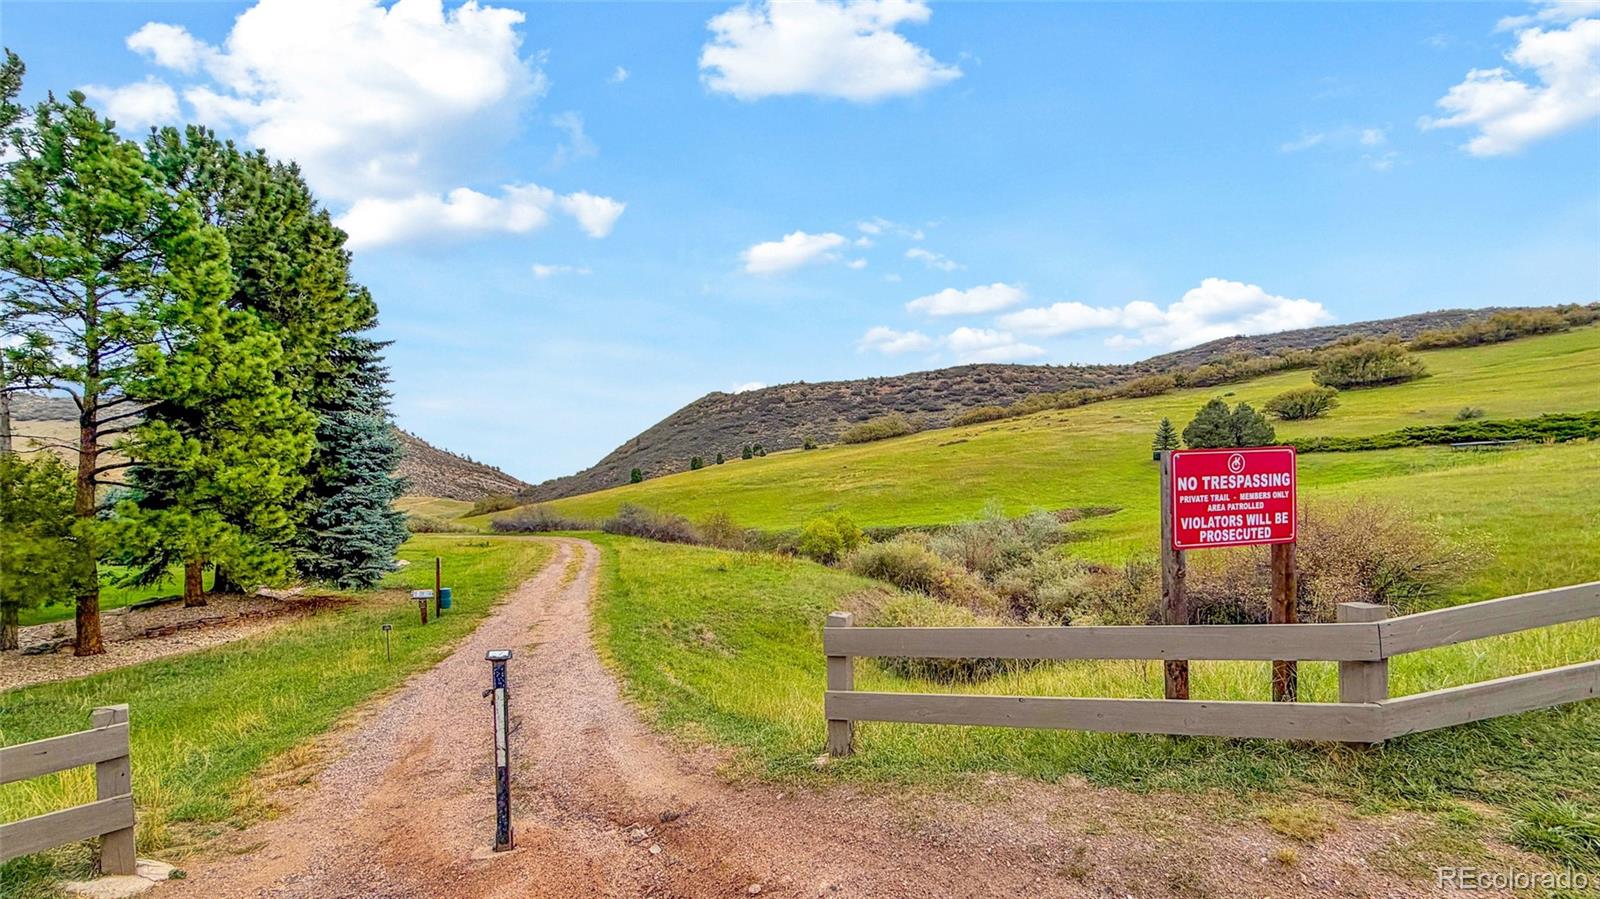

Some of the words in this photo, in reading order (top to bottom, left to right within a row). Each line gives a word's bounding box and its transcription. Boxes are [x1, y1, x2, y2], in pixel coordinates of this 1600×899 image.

[1177, 476, 1198, 491] NO
[1202, 473, 1290, 490] TRESPASSING
[1179, 494, 1209, 503] PRIVATE
[1211, 494, 1230, 502] TRAIL
[1240, 491, 1271, 500] MEMBERS
[1272, 491, 1289, 499] ONLY
[1207, 503, 1226, 512] AREA
[1227, 502, 1265, 511] PATROLLED
[1181, 514, 1243, 529] VIOLATORS
[1246, 513, 1272, 526] WILL
[1274, 512, 1289, 524] BE
[1199, 527, 1271, 542] PROSECUTED
